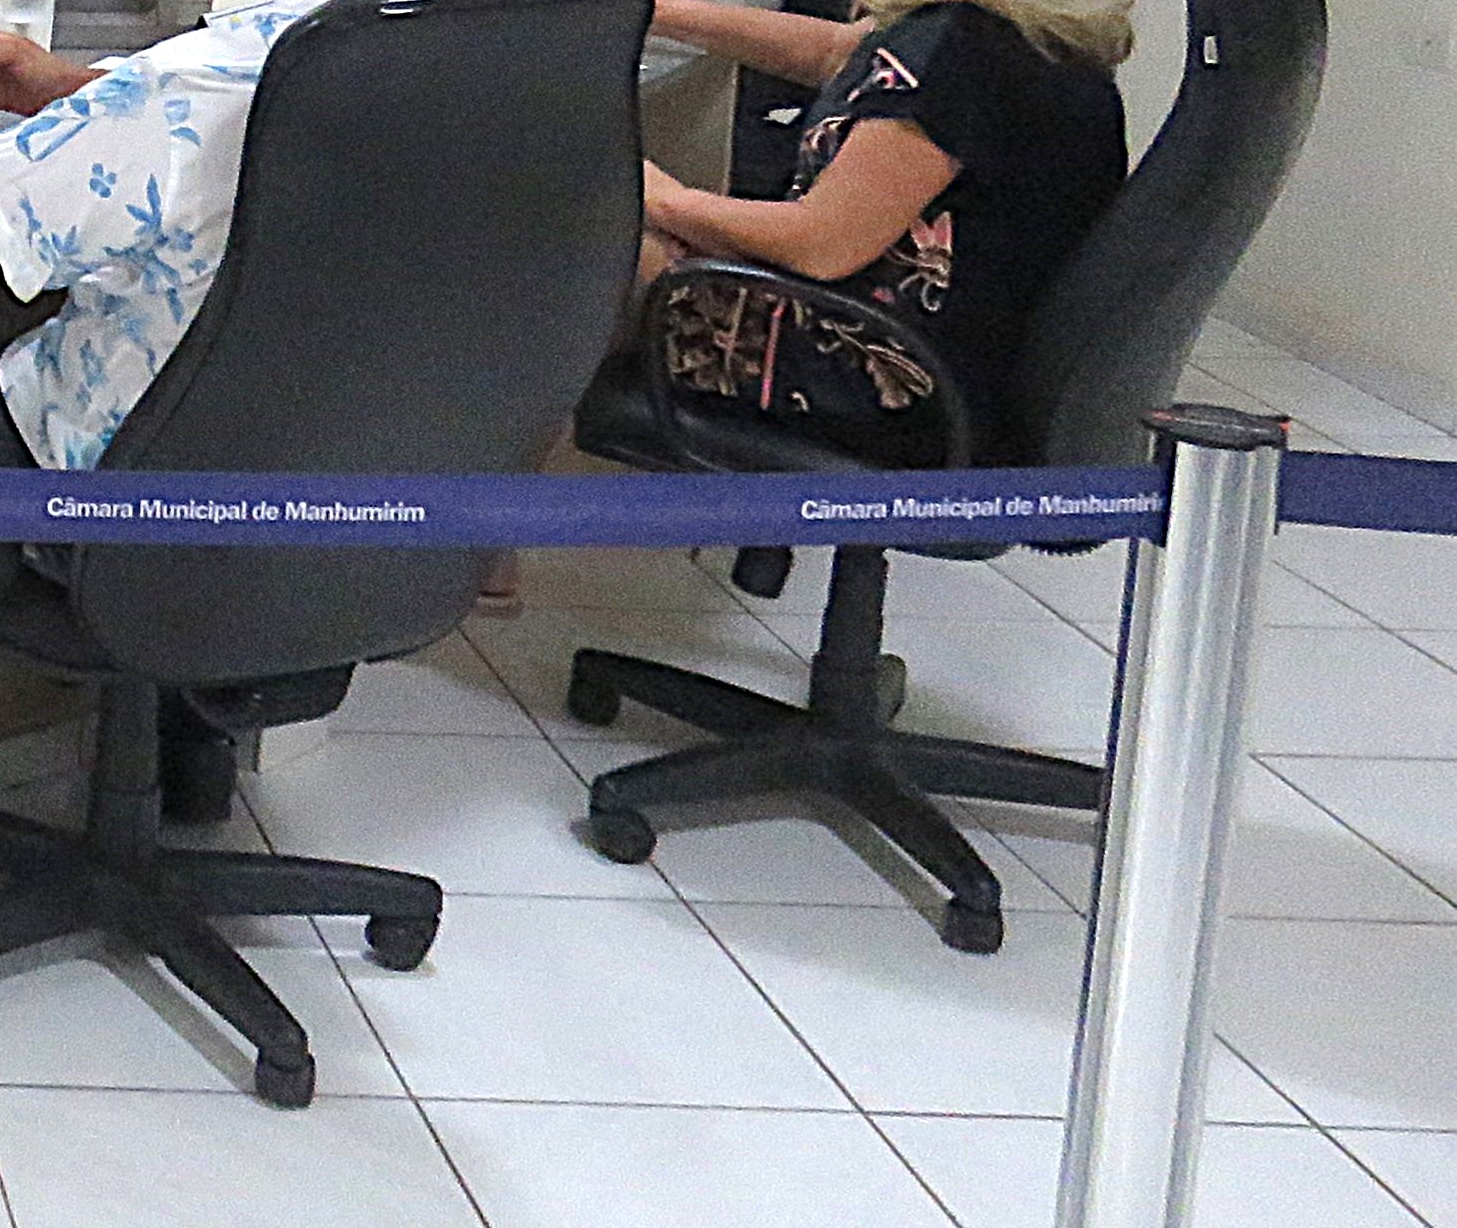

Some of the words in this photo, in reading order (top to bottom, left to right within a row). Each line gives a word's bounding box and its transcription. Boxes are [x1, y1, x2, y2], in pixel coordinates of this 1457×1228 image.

[47, 496, 133, 518] Câmara
[140, 498, 248, 523] Municipal
[252, 499, 280, 521] de
[286, 500, 426, 523] Manhumirim
[800, 499, 887, 520] Câmara
[892, 497, 1001, 520] Municipal
[1005, 496, 1034, 517] de
